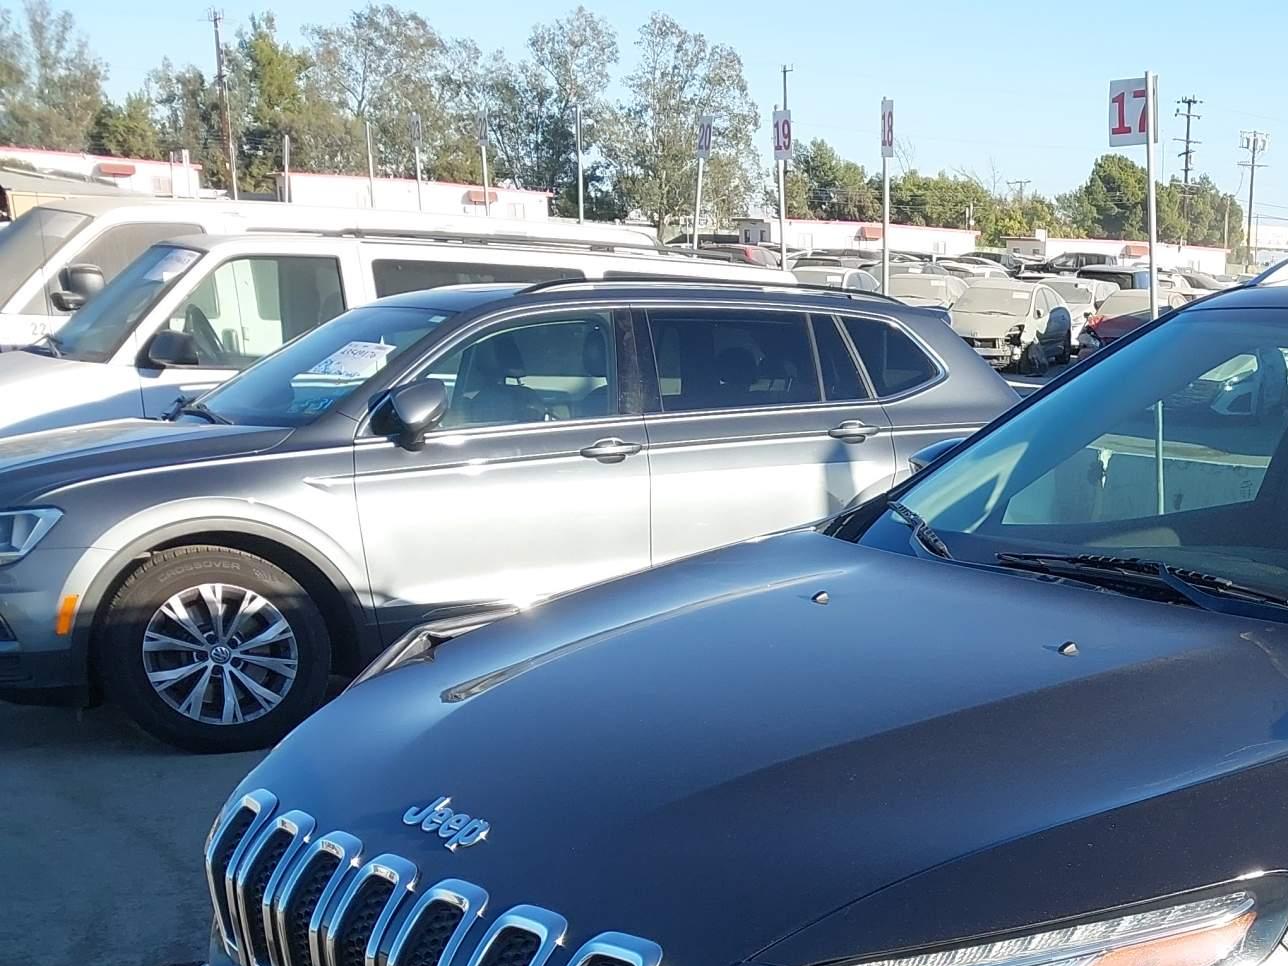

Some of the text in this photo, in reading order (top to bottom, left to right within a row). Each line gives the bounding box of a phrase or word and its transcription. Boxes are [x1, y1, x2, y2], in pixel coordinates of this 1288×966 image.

[882, 111, 893, 147] 18
[1111, 89, 1146, 135] 17
[699, 123, 712, 151] 20
[774, 119, 791, 151] 19
[159, 560, 241, 583] CROSSOVER
[403, 796, 491, 853] Jeep
